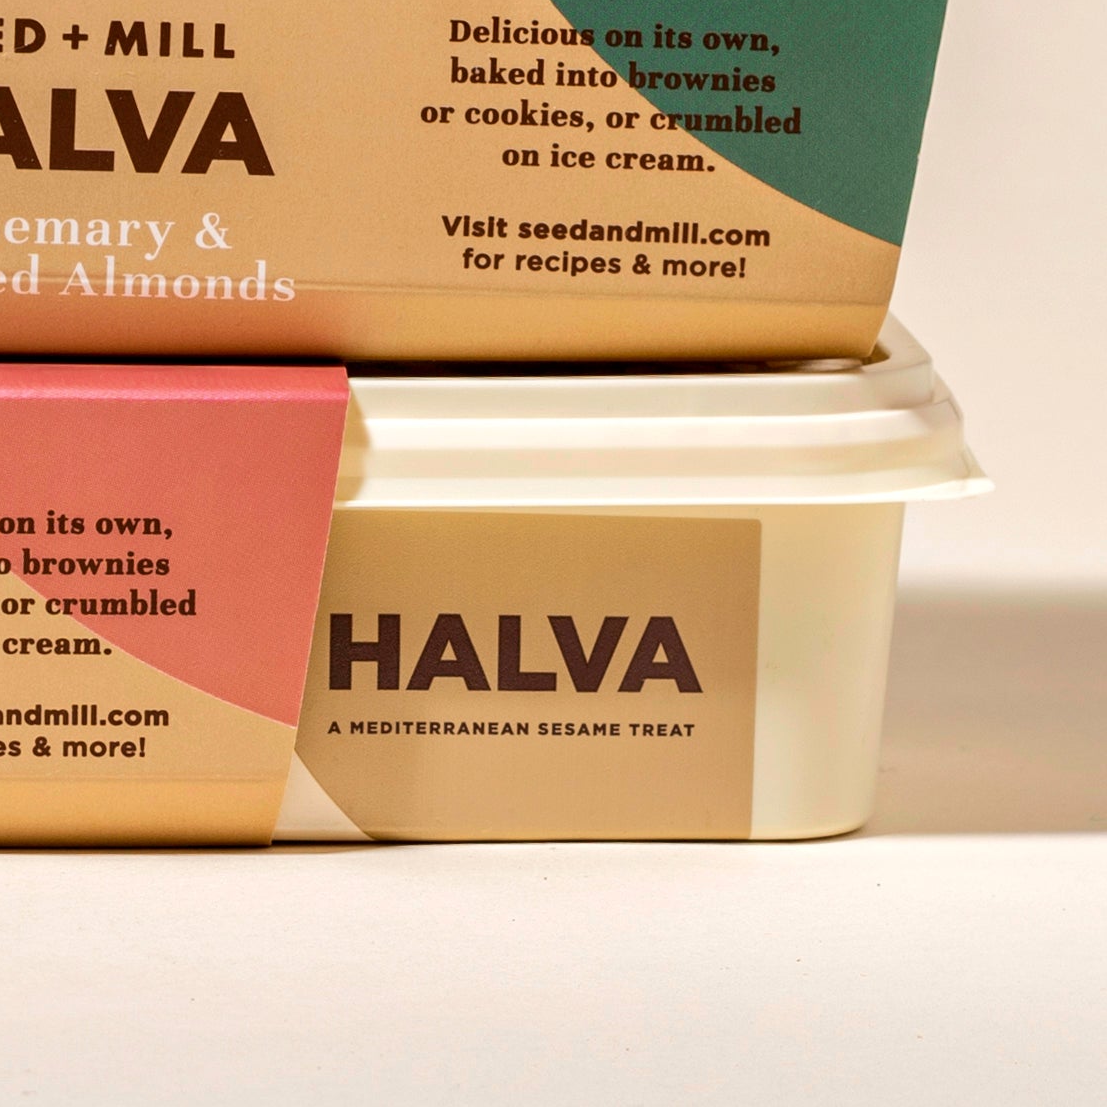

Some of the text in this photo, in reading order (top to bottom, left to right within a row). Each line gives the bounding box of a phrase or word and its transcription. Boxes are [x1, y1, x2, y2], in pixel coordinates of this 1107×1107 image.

[63, 25, 88, 49] +
[105, 21, 234, 58] MILL
[449, 16, 779, 56] Delicious on its own,
[451, 56, 776, 93] baked into brownies
[421, 99, 802, 135] or cookies, or crumbled
[502, 143, 715, 172] on ice cream.
[195, 213, 231, 249] &
[442, 215, 770, 246] Visit seedandmill.com
[61, 255, 295, 300] Almonds
[463, 248, 745, 278] for recipes & more!
[47, 510, 84, 534] its
[96, 518, 172, 539] own,
[23, 548, 169, 575] brownies
[1, 598, 35, 614] or
[46, 589, 196, 616] crumbled
[3, 638, 112, 655] cream.
[329, 613, 703, 693] HALVA
[328, 721, 694, 736] A MEDITERRANEAN SESAME TREAT
[33, 737, 51, 756] &
[63, 737, 145, 757] more!
